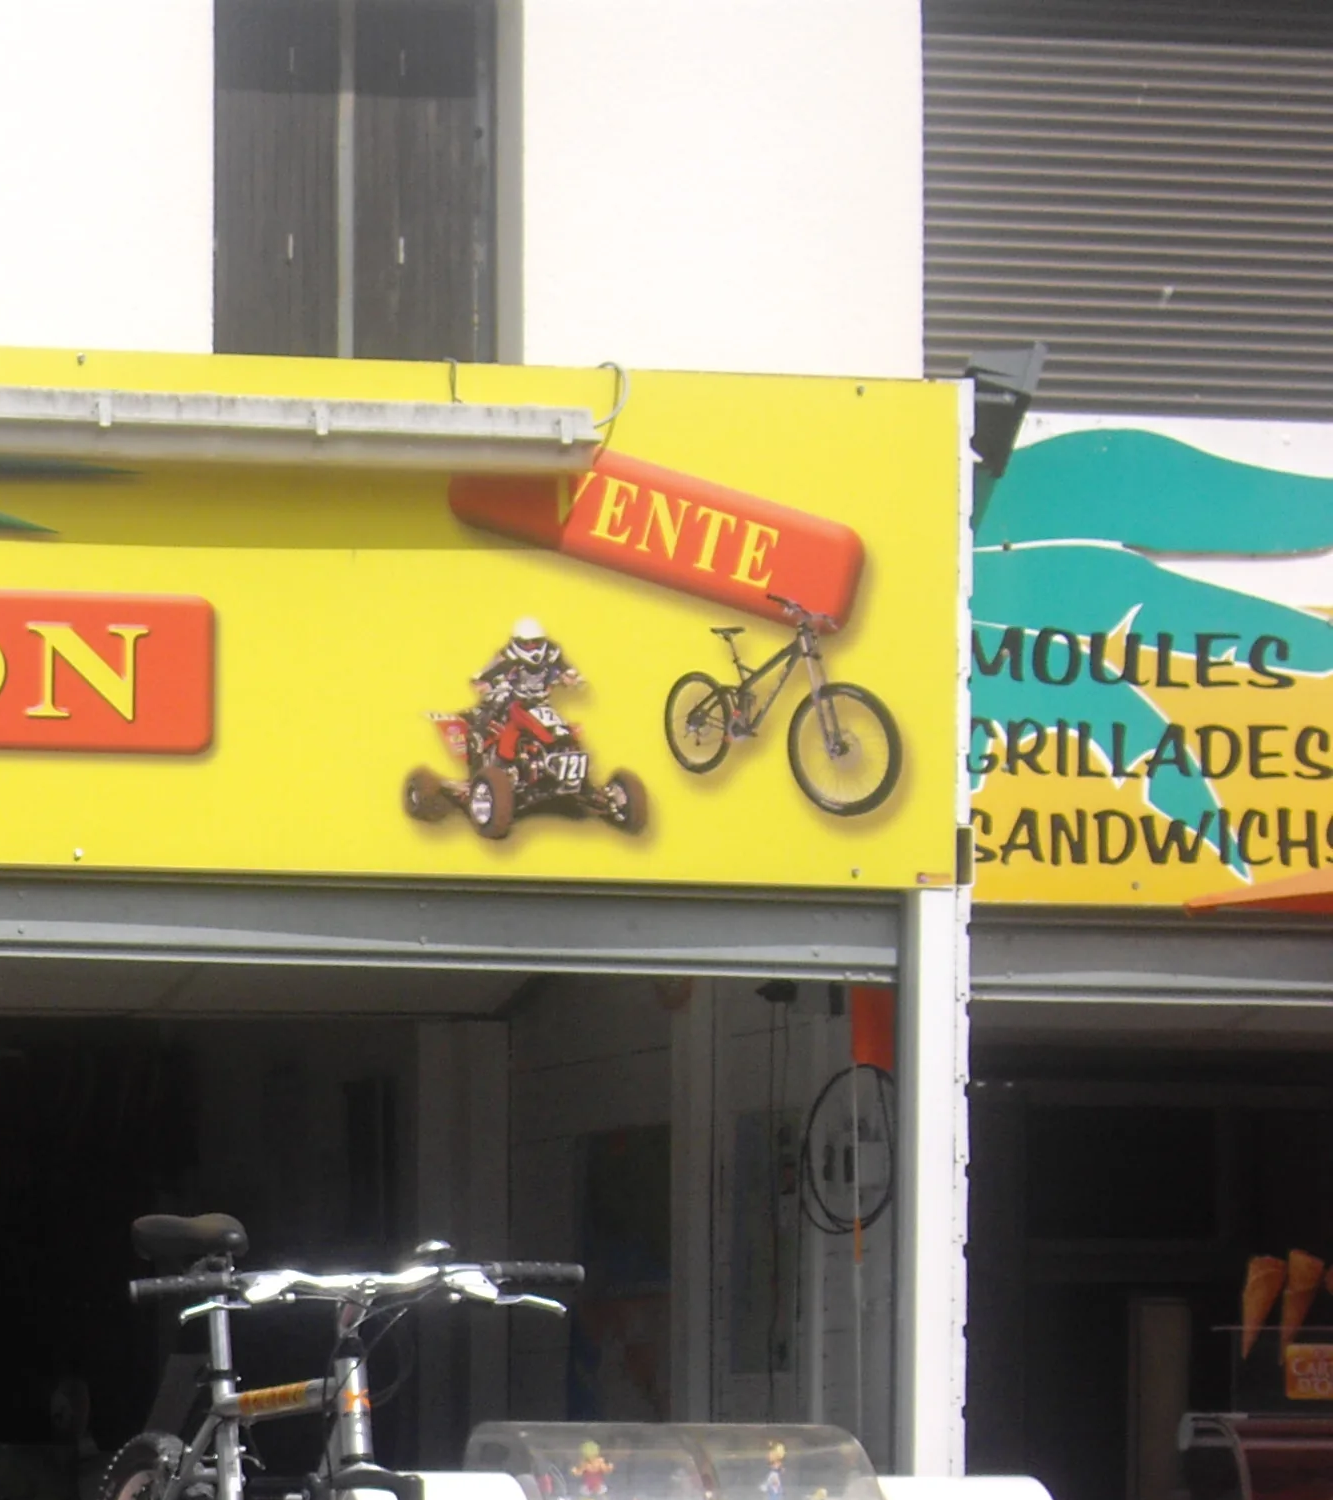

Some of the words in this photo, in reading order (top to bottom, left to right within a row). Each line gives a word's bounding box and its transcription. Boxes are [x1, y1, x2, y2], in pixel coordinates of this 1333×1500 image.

[556, 471, 779, 589] VENTE
[968, 627, 1297, 689] MOULES
[966, 718, 1333, 780] GRILLADES
